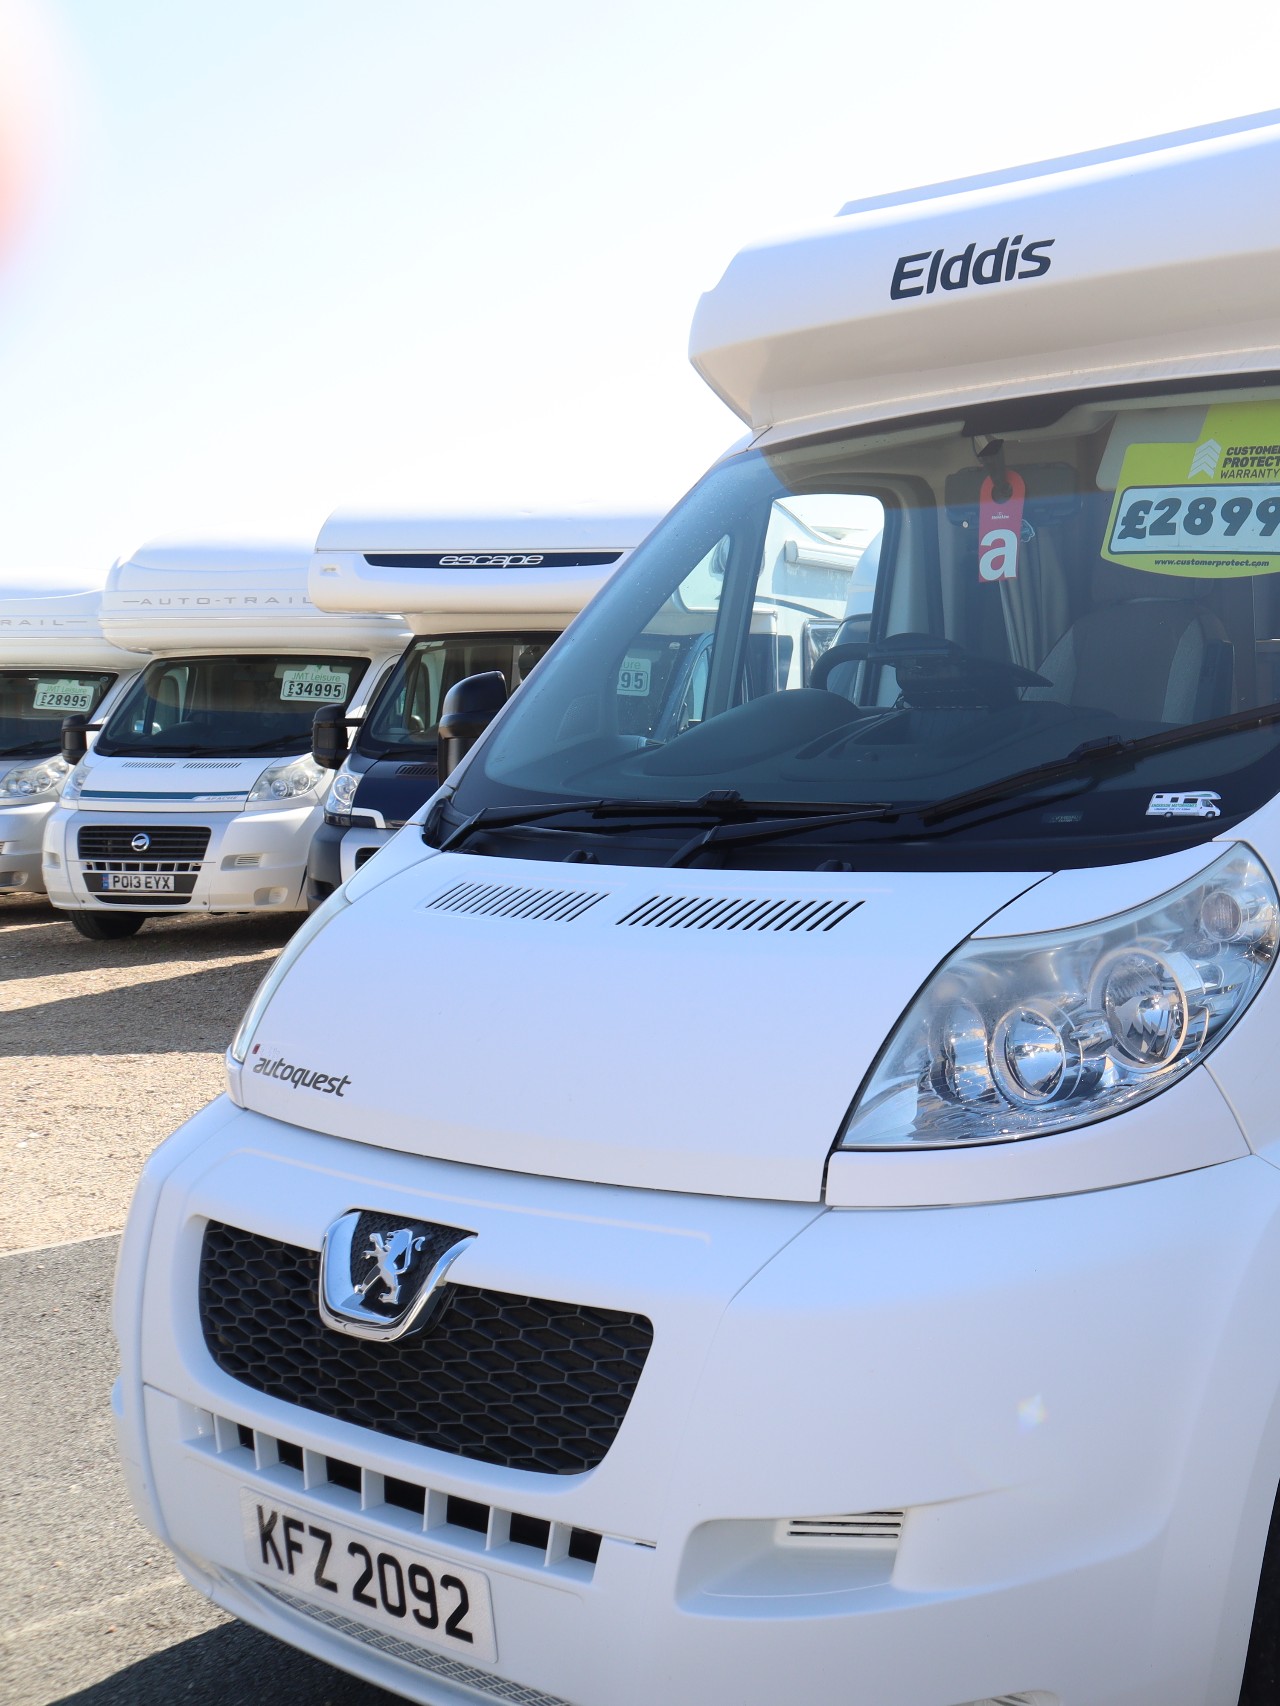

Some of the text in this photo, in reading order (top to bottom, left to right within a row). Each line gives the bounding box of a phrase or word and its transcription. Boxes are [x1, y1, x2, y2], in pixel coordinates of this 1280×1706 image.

[890, 234, 1056, 301] Elddis
[1220, 468, 1280, 480] WARRANTY
[439, 555, 544, 568] escape
[1154, 558, 1270, 568] www.customerprotect.com
[292, 672, 341, 682] JMT Leisure
[288, 681, 342, 698] £34995
[41, 692, 88, 707] £28995
[112, 875, 171, 890] PO13 EYX
[252, 1058, 352, 1098] autoquest
[256, 1504, 474, 1644] KFZ 2092
